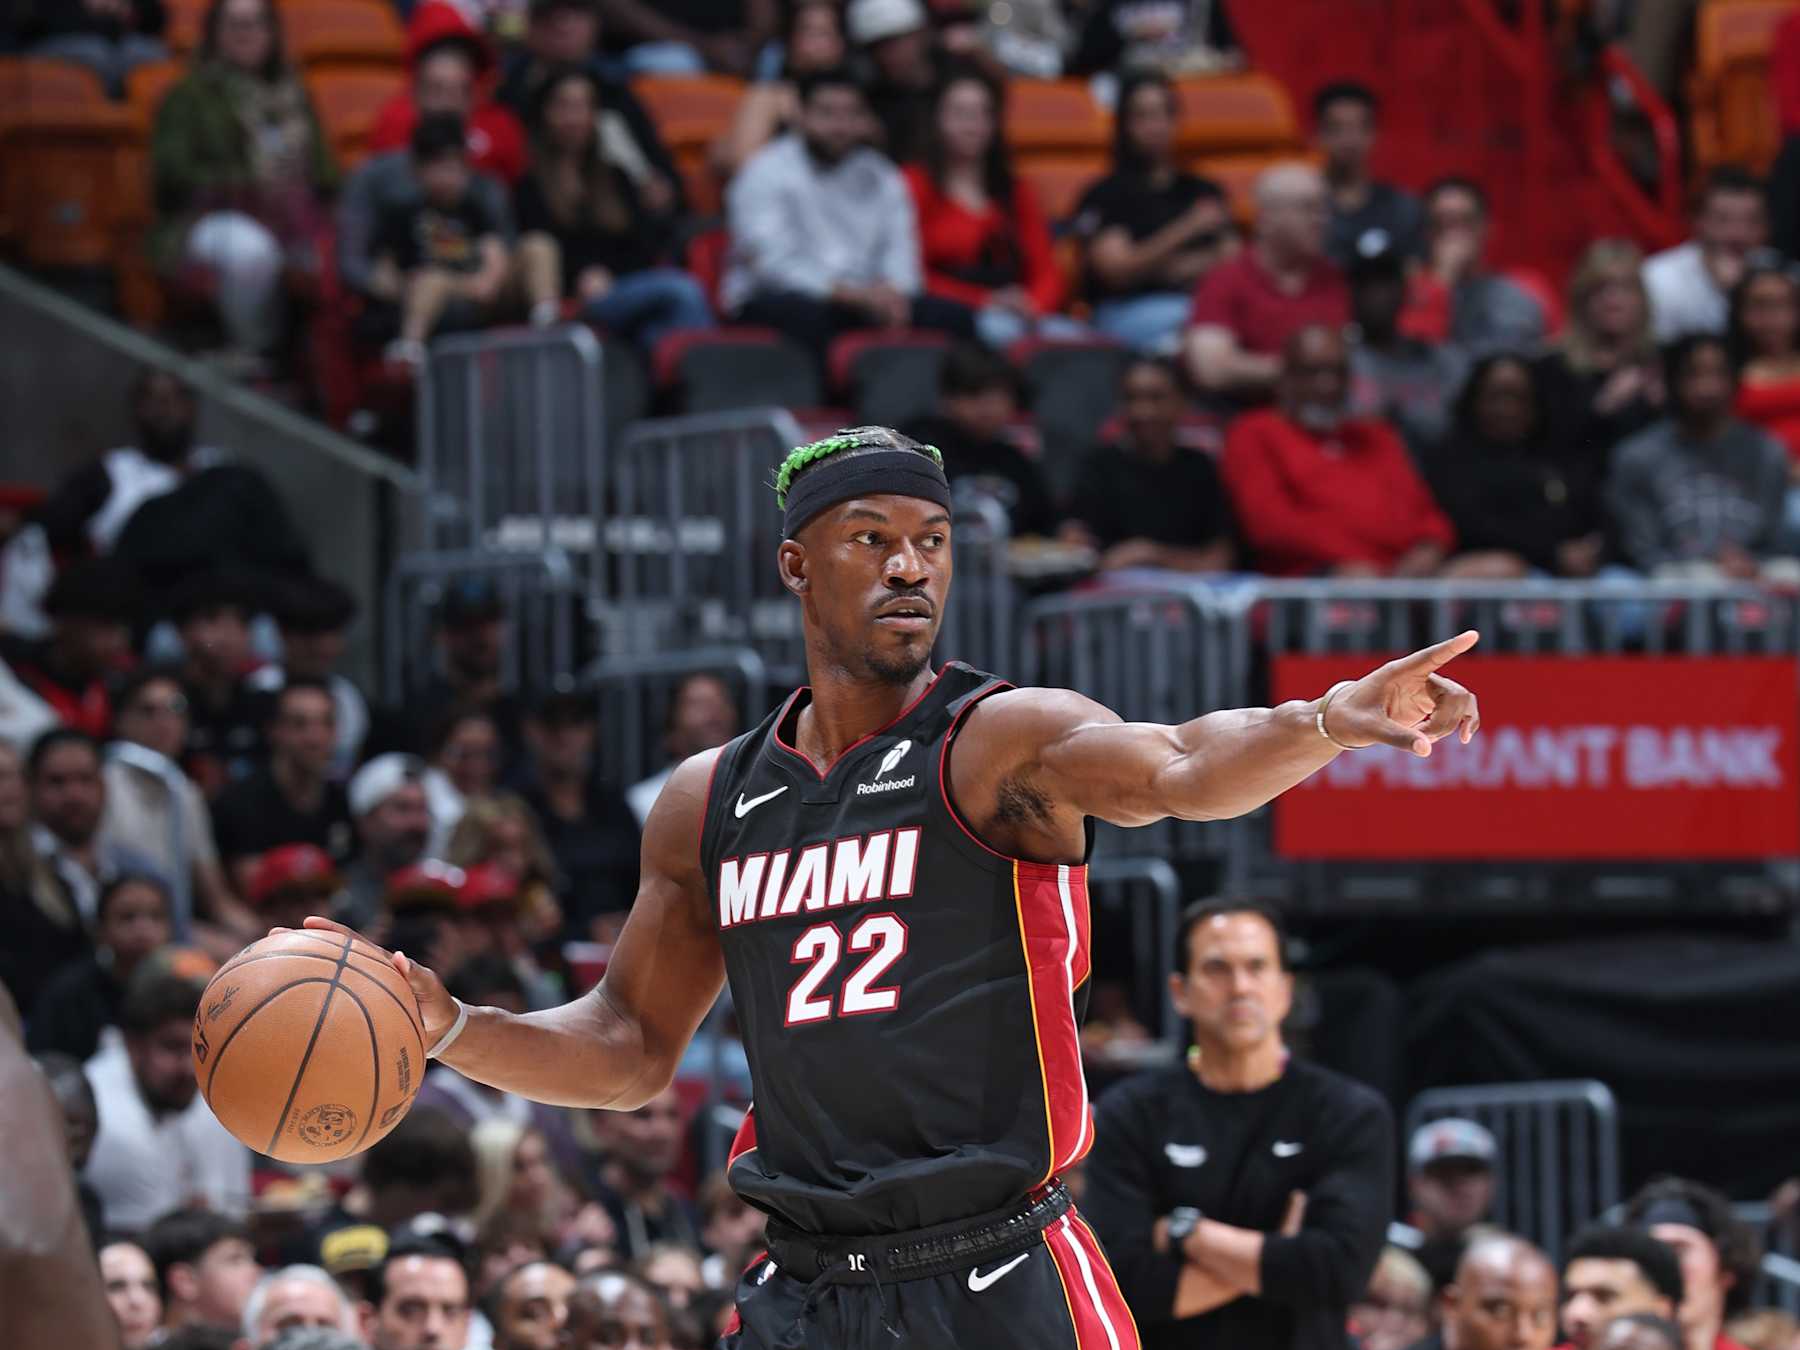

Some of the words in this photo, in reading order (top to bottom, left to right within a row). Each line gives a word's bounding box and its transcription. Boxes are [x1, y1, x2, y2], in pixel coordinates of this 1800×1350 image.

[857, 775, 915, 795] Robinhood
[1626, 726, 1782, 789] BANK
[719, 826, 922, 930] MIAMI
[784, 912, 909, 1028] 22
